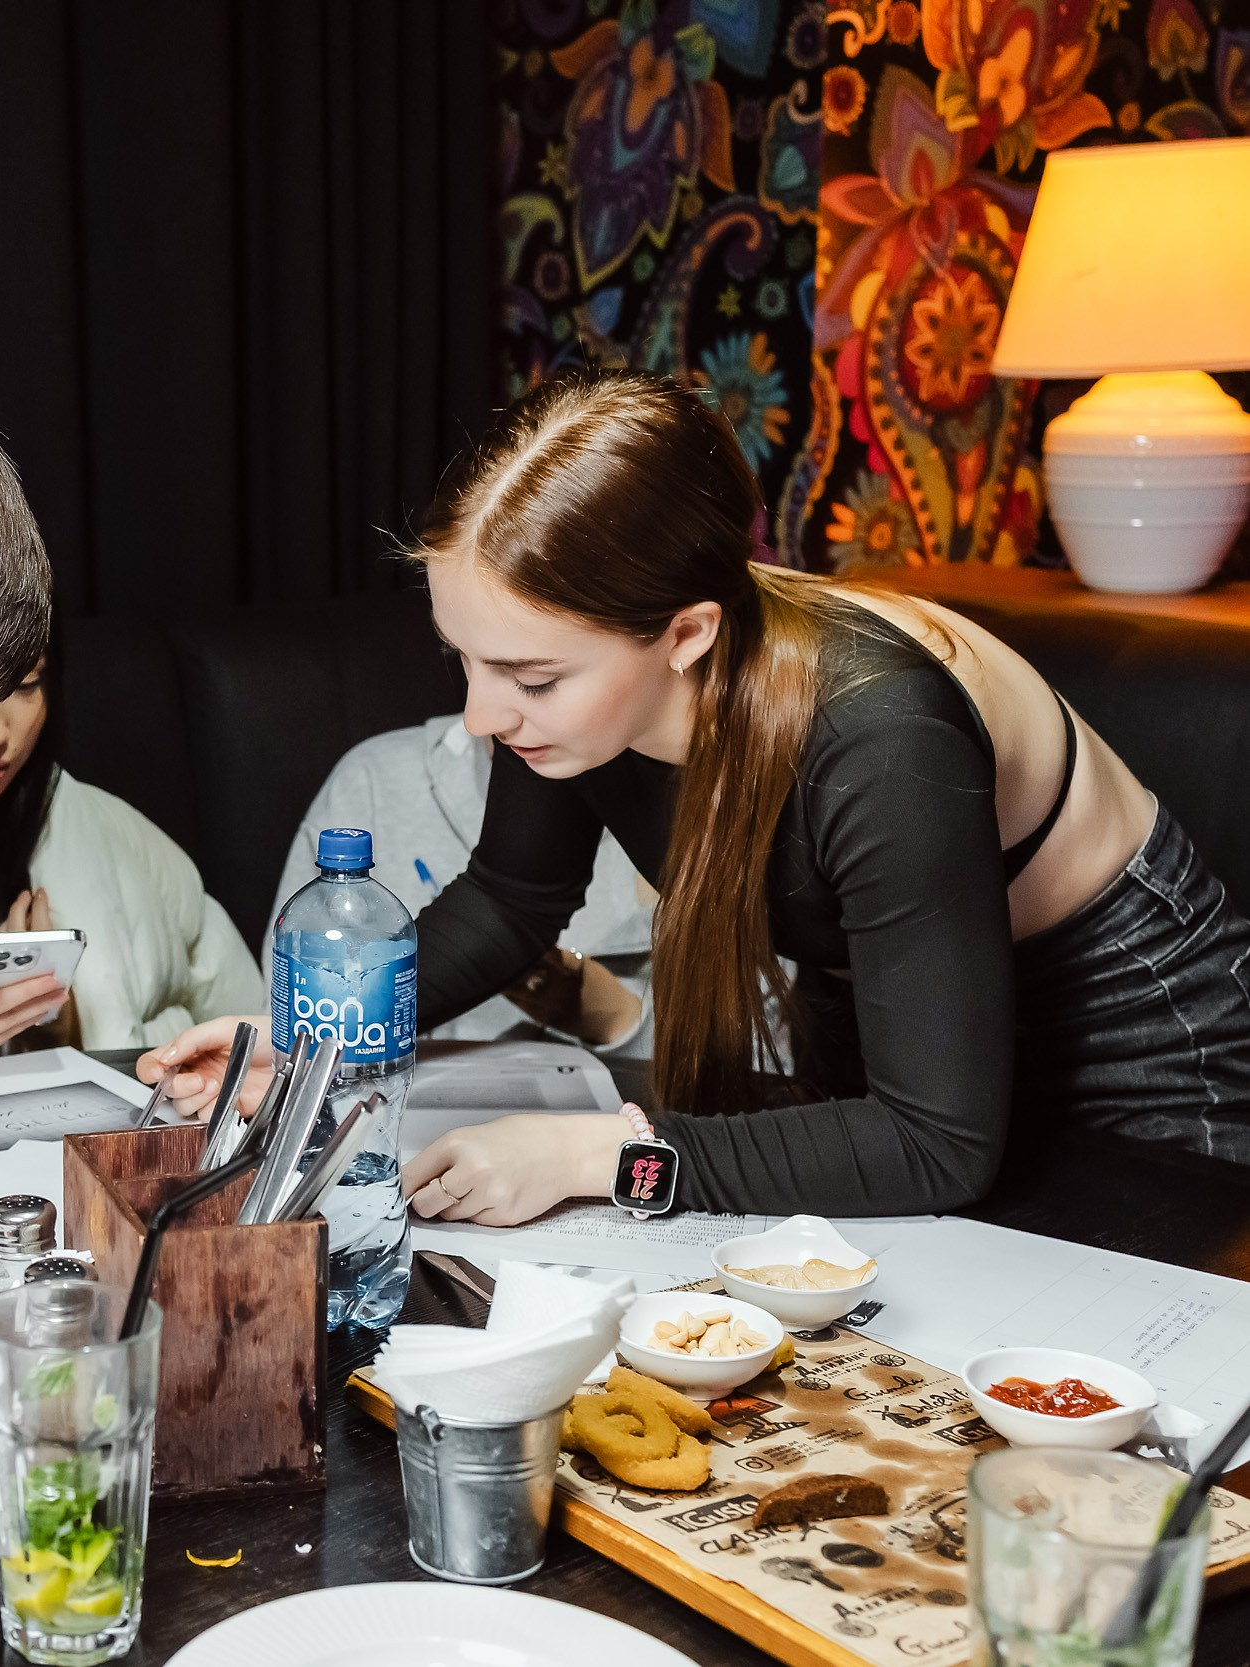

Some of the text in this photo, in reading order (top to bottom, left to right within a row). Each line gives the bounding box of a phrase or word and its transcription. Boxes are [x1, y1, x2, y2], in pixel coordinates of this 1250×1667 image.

[294, 988, 364, 1022] bon
[632, 1158, 664, 1180] 23
[630, 1179, 658, 1200] 21
